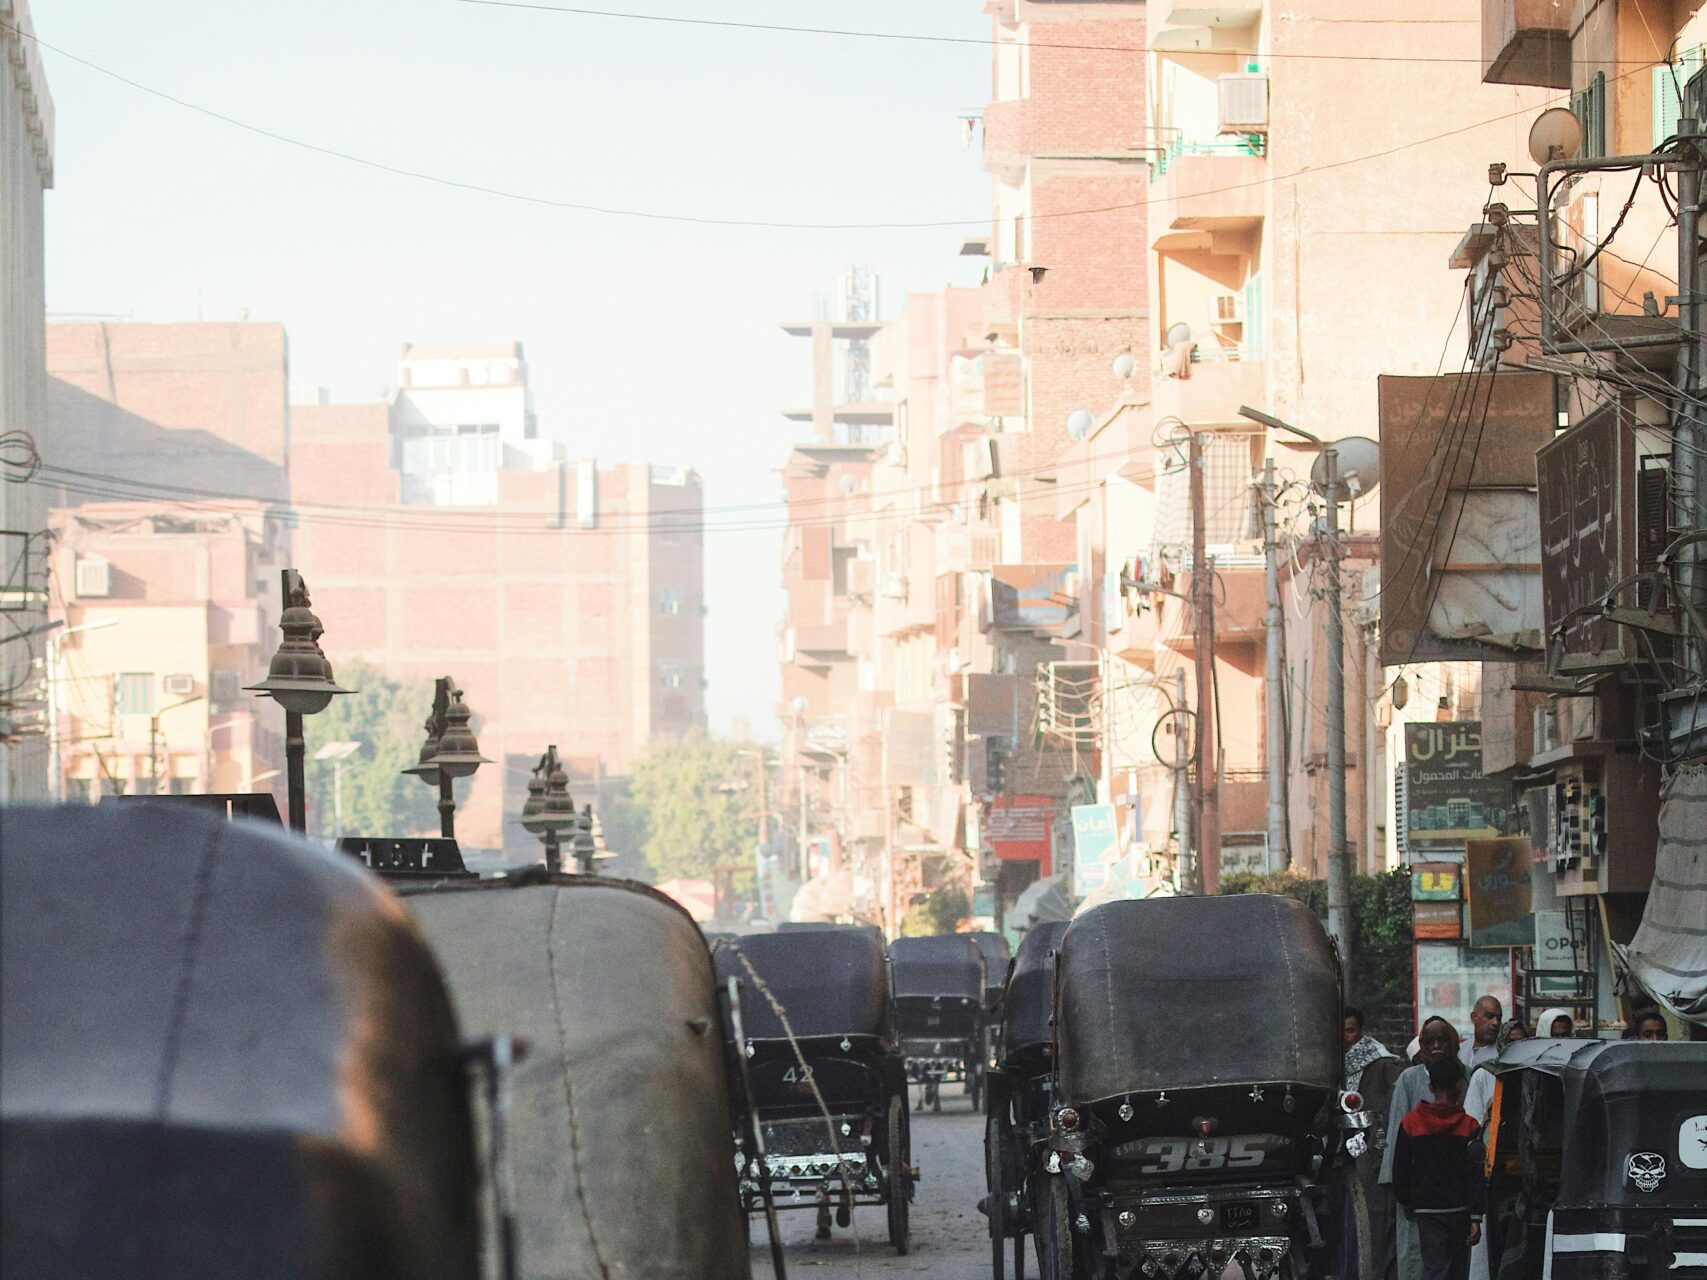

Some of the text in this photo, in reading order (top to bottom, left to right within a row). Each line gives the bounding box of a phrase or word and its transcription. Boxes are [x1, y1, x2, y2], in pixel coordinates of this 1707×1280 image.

[1412, 726, 1482, 761] جنرال
[1412, 770, 1460, 785] المحمول
[1141, 1136, 1267, 1173] 385
